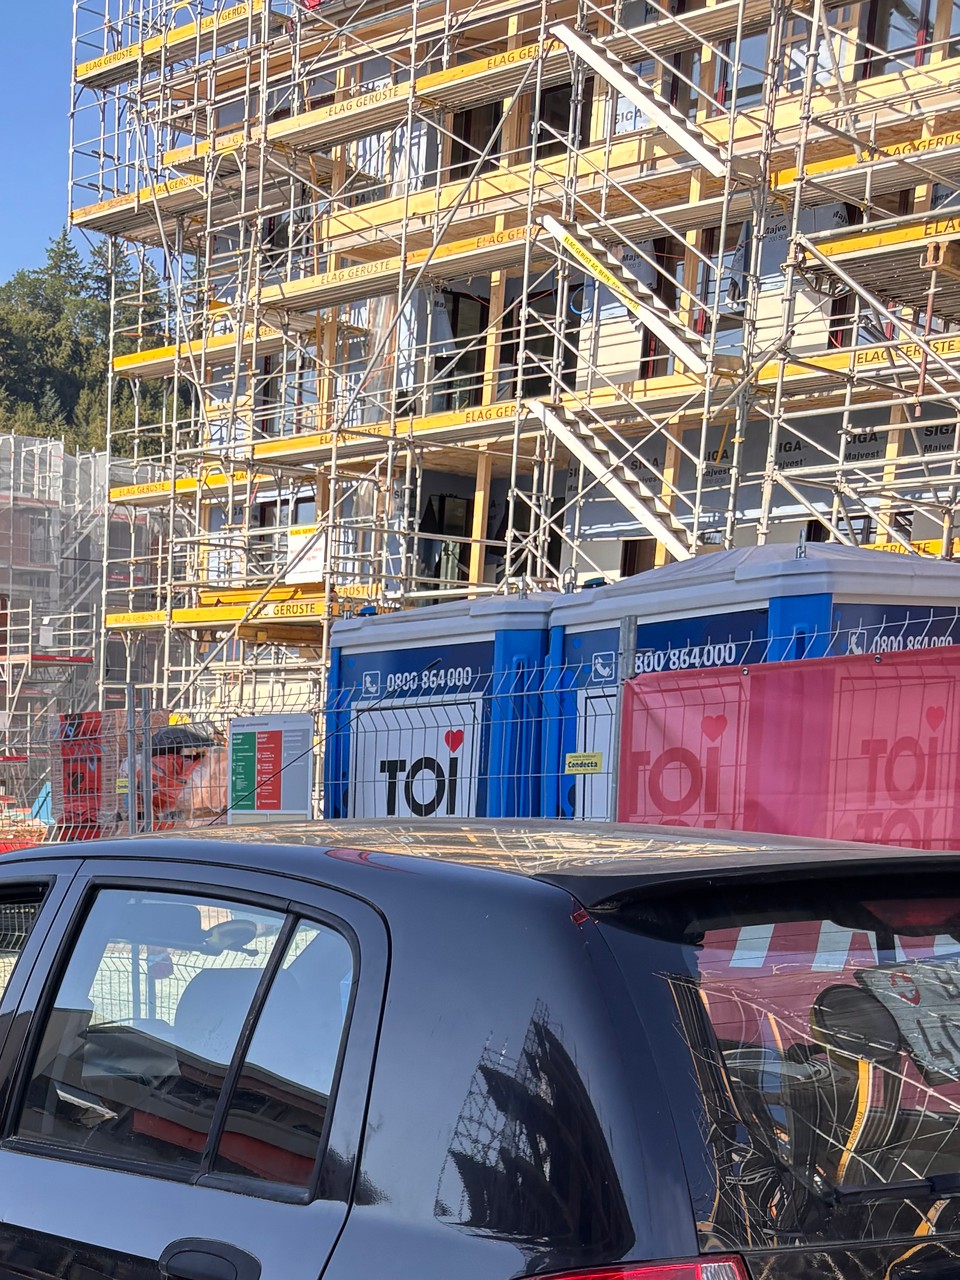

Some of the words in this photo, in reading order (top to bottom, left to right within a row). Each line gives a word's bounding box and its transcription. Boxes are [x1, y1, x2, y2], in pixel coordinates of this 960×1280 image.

[85, 57, 102, 72] ELAG
[487, 49, 515, 69] ELAG
[329, 98, 352, 117] ELAG
[917, 132, 960, 152] GERÜS
[924, 218, 960, 237] ELA
[477, 232, 503, 248] ELAG
[321, 268, 345, 285] ELAG
[465, 406, 491, 423] ELAG
[777, 458, 803, 469] ajvest
[273, 603, 316, 616] GERÜSTE
[634, 651, 665, 674] 800
